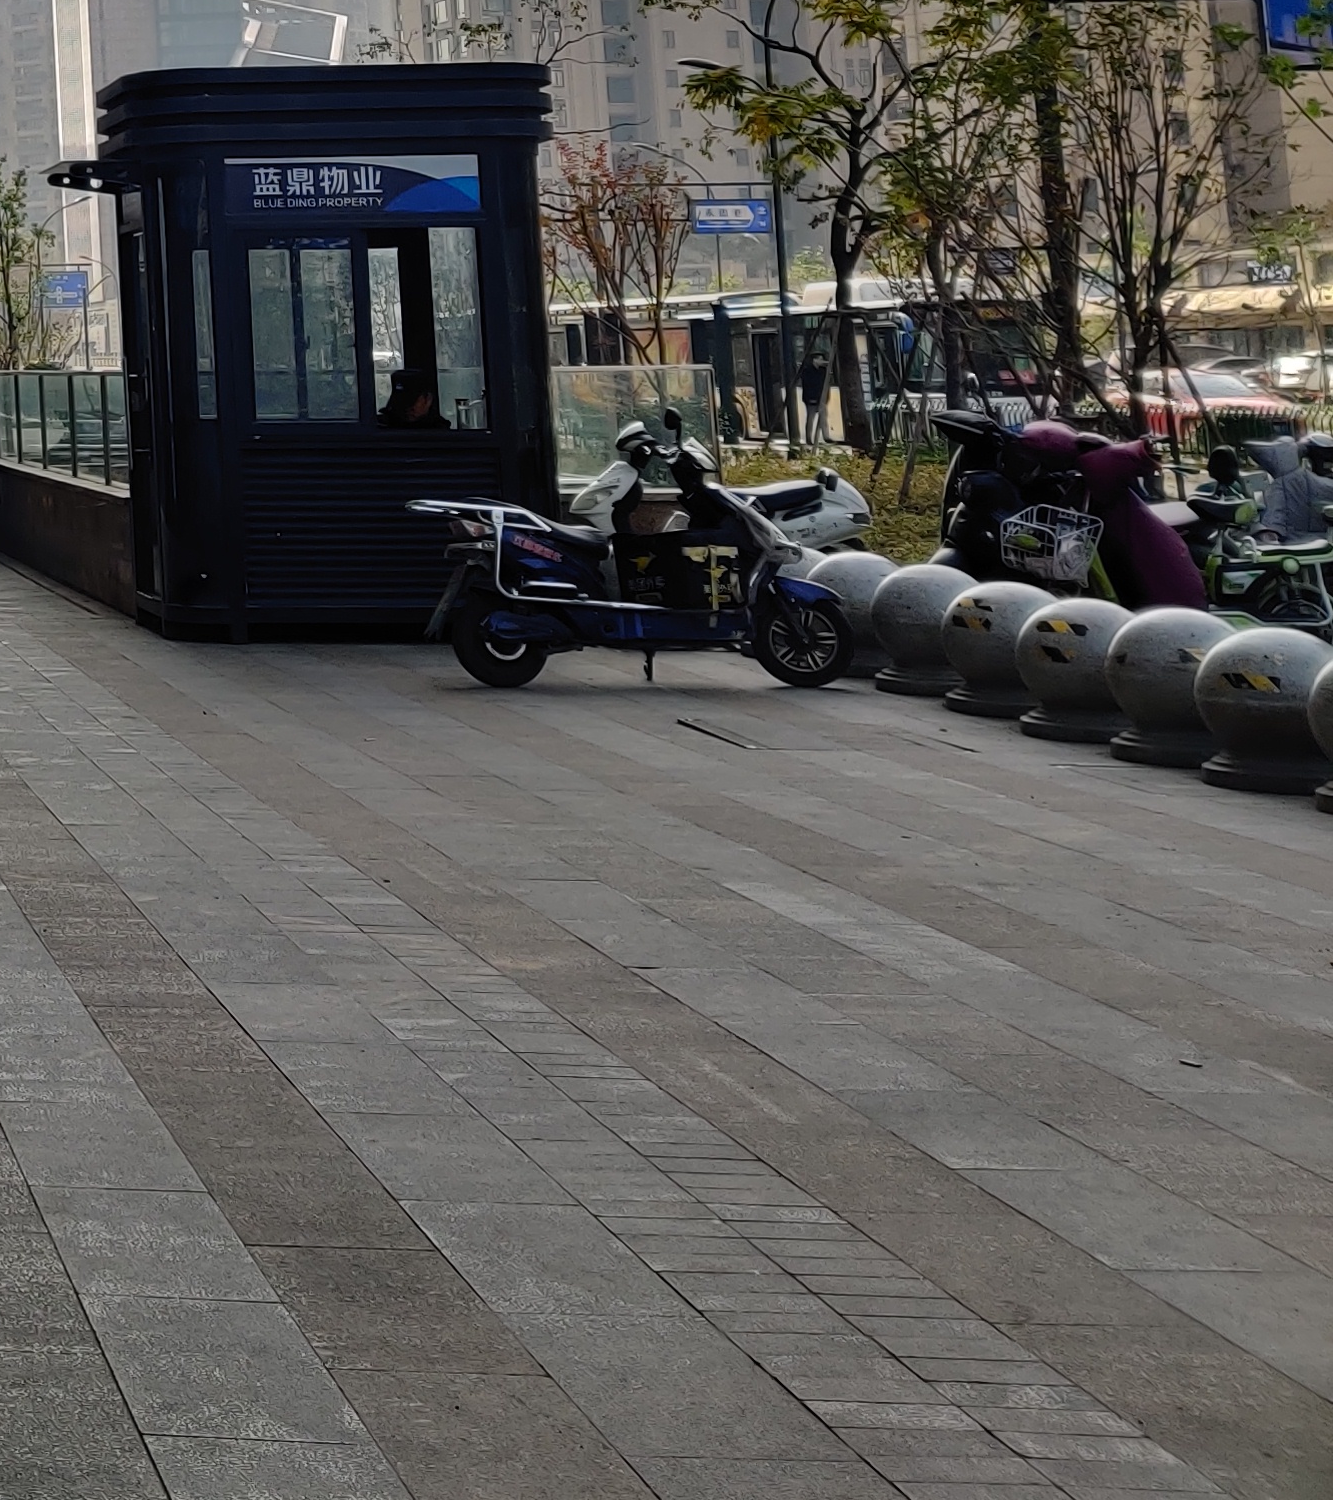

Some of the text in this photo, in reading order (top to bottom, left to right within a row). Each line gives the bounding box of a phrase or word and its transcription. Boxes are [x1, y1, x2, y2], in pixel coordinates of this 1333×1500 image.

[252, 166, 383, 196] 蓝鼎物业
[253, 197, 384, 208] BLUE DING PROPERTY
